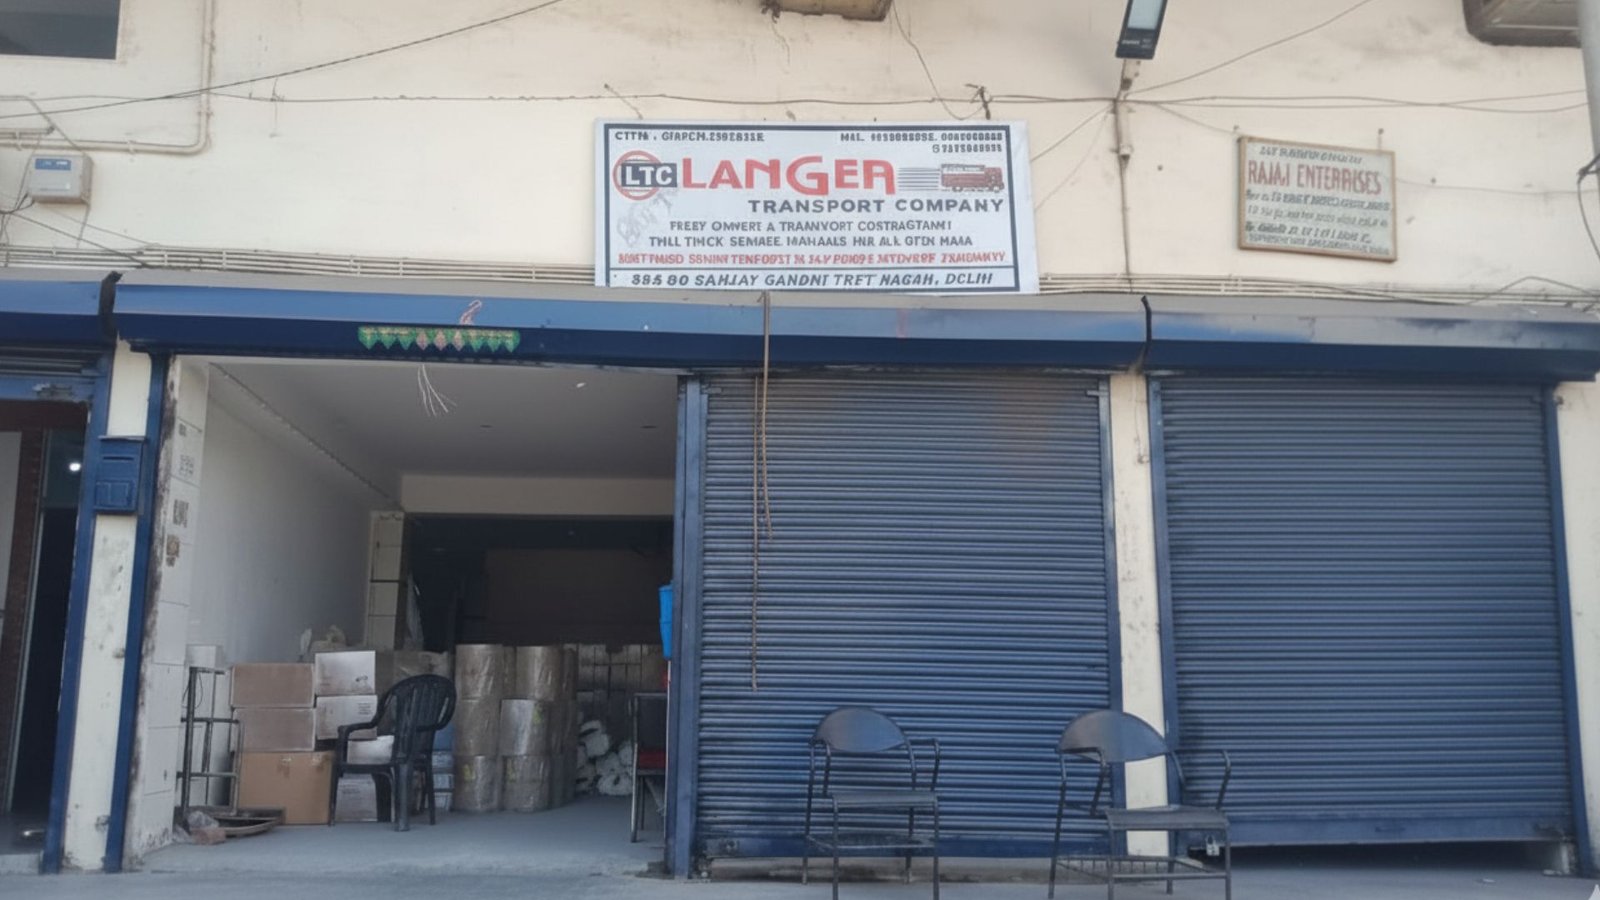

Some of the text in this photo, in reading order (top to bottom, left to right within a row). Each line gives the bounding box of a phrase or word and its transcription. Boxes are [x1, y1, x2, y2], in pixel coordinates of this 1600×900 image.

[625, 166, 673, 186] LTC
[748, 198, 1004, 214] TRANSPORT COMPANY
